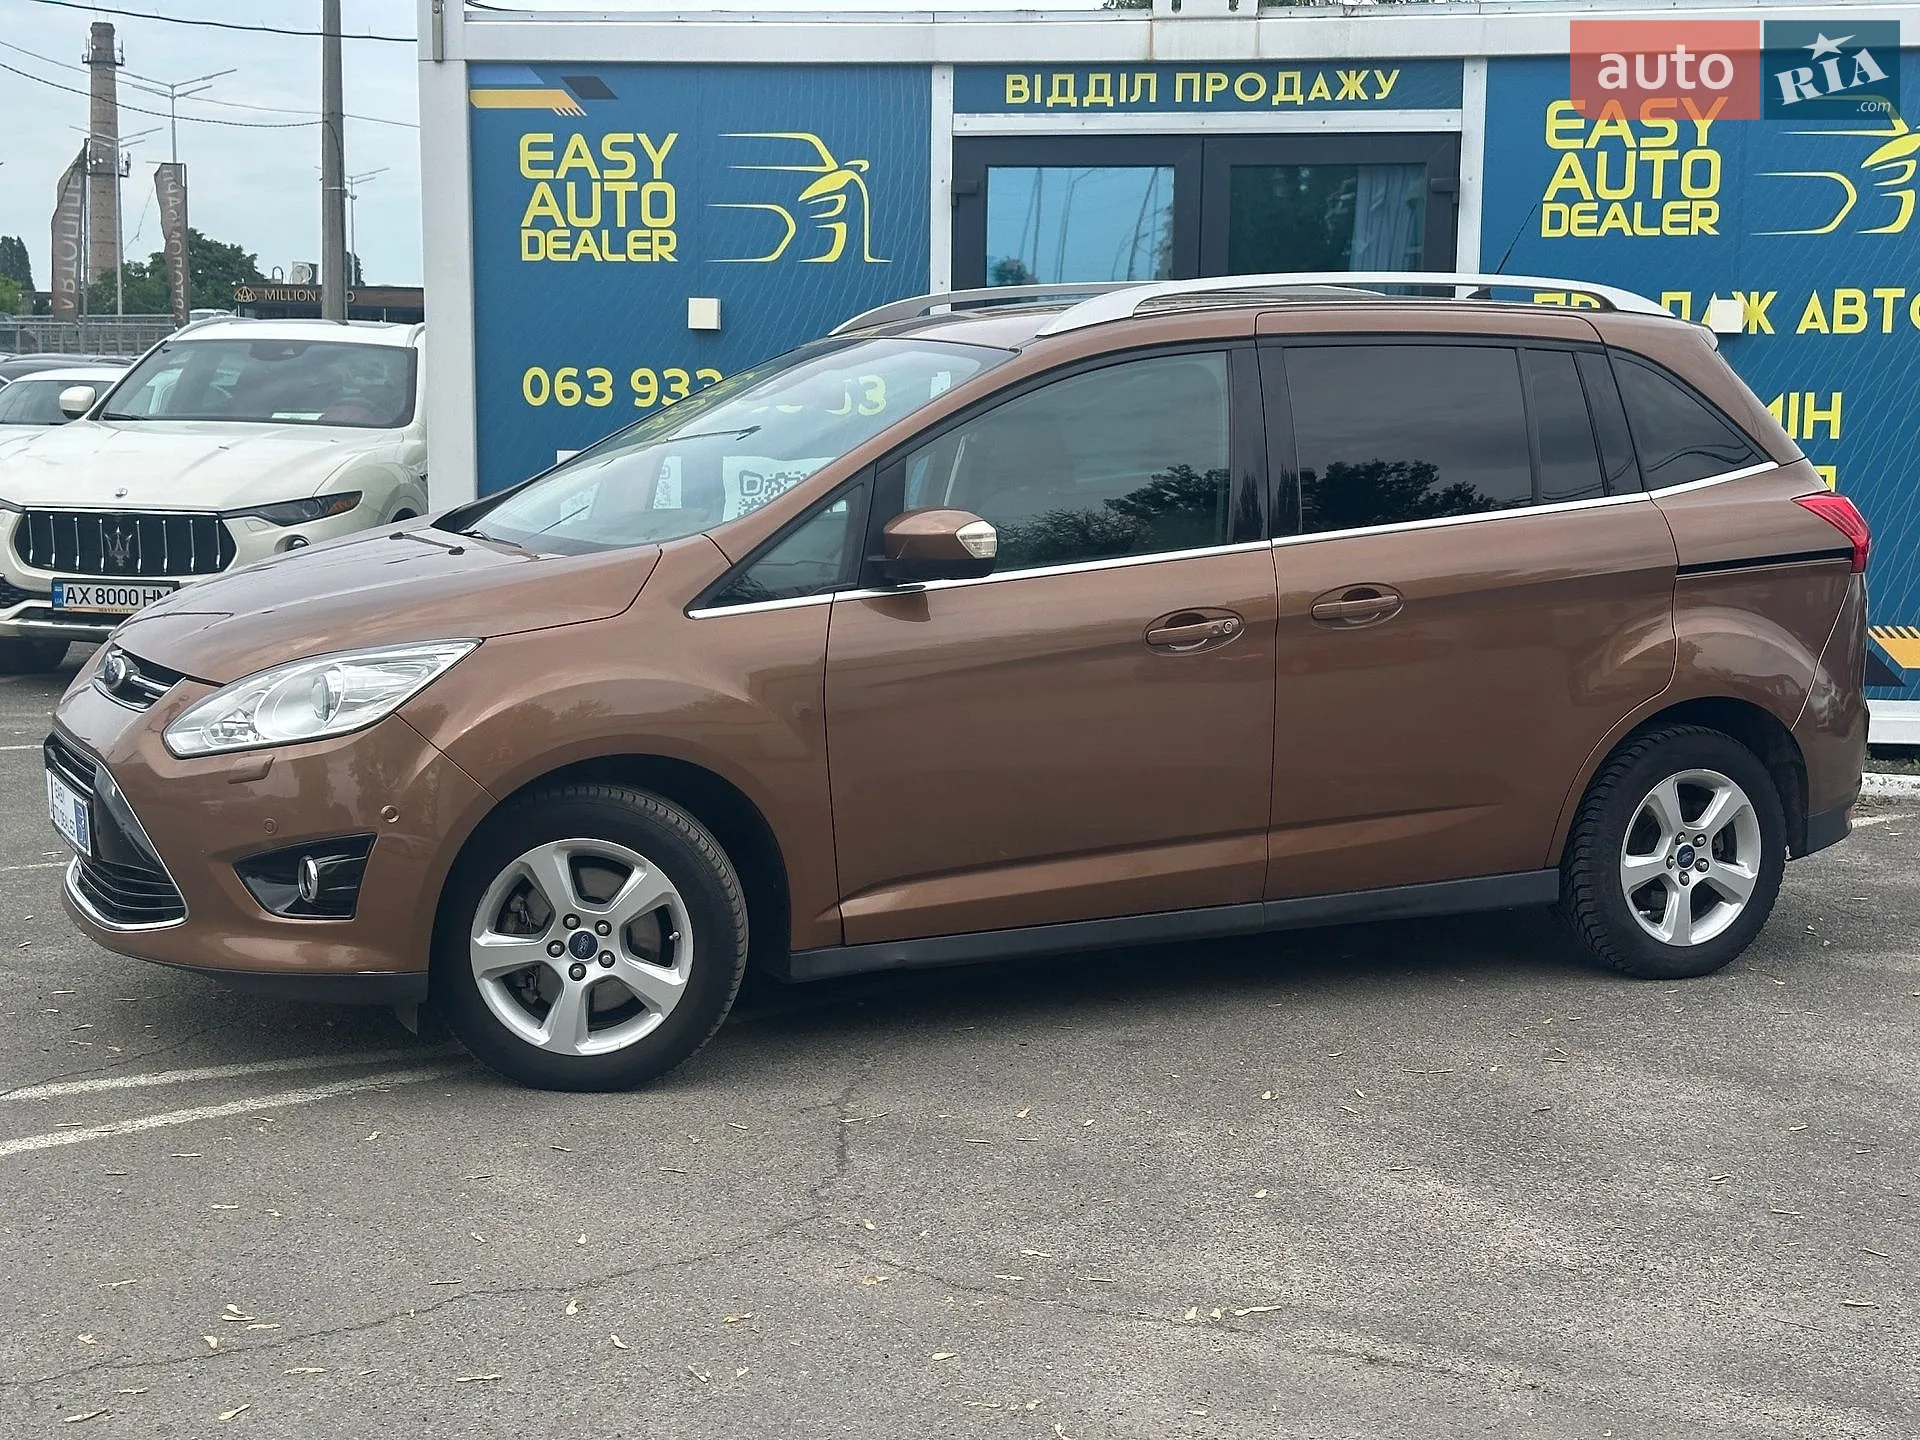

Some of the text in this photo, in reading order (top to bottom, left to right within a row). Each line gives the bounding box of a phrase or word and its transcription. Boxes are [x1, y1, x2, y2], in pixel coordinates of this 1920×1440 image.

[1006, 69, 1400, 108] ВІДДІЛ ПРОДАЖУ
[1544, 97, 1727, 150] EASY
[519, 132, 678, 180] EASY
[1543, 148, 1721, 202] AUTO
[520, 181, 677, 228] AUTO
[1541, 201, 1720, 238] DEALER
[520, 229, 678, 263] DEALER
[264, 289, 316, 301] MILLION
[1796, 287, 1920, 335] АВТ
[522, 366, 613, 407] 063
[65, 587, 91, 604] AX
[95, 588, 139, 605] 8000
